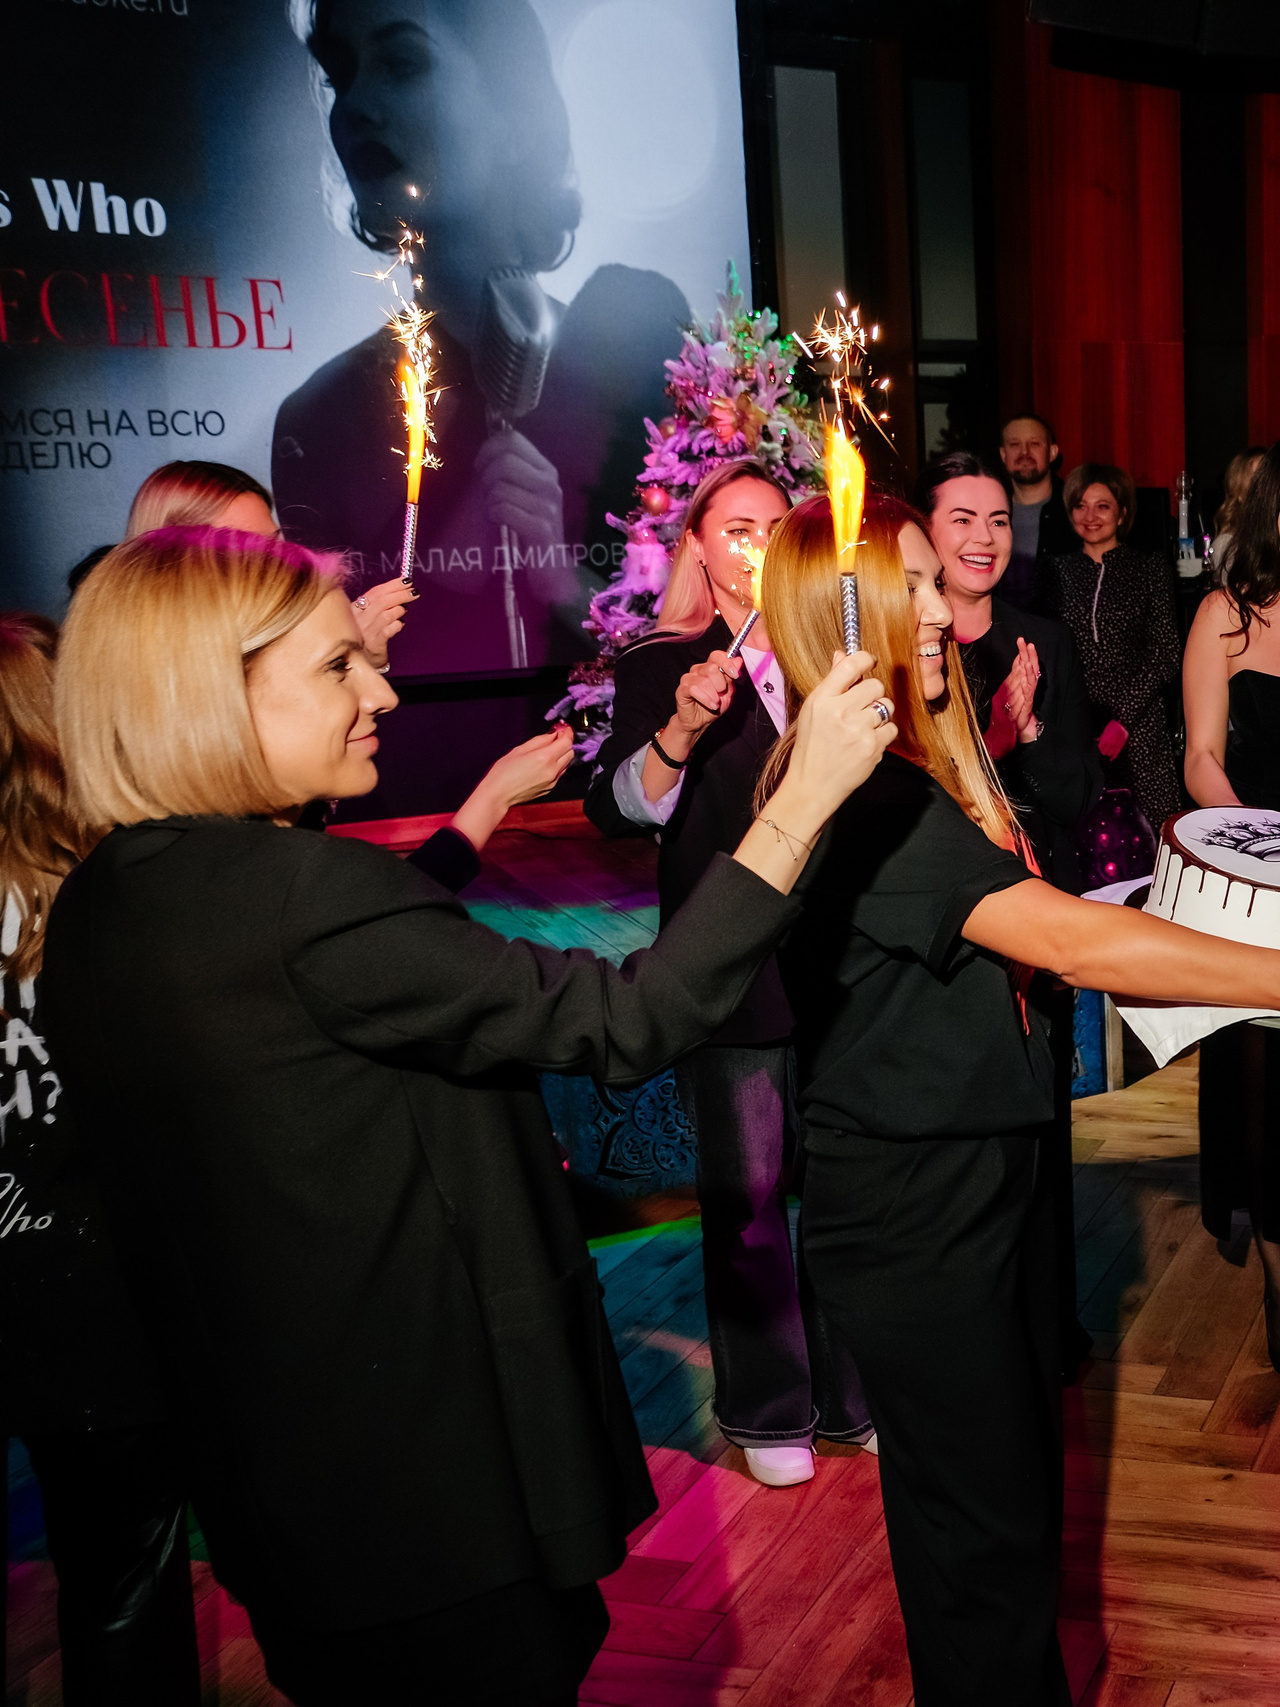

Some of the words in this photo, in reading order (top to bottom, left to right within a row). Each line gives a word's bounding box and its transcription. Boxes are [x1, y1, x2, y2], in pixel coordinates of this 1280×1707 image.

[30, 177, 167, 237] Who
[87, 408, 139, 436] НА
[147, 409, 225, 437] ВСЮ
[1, 442, 111, 475] ДЕЛЮ
